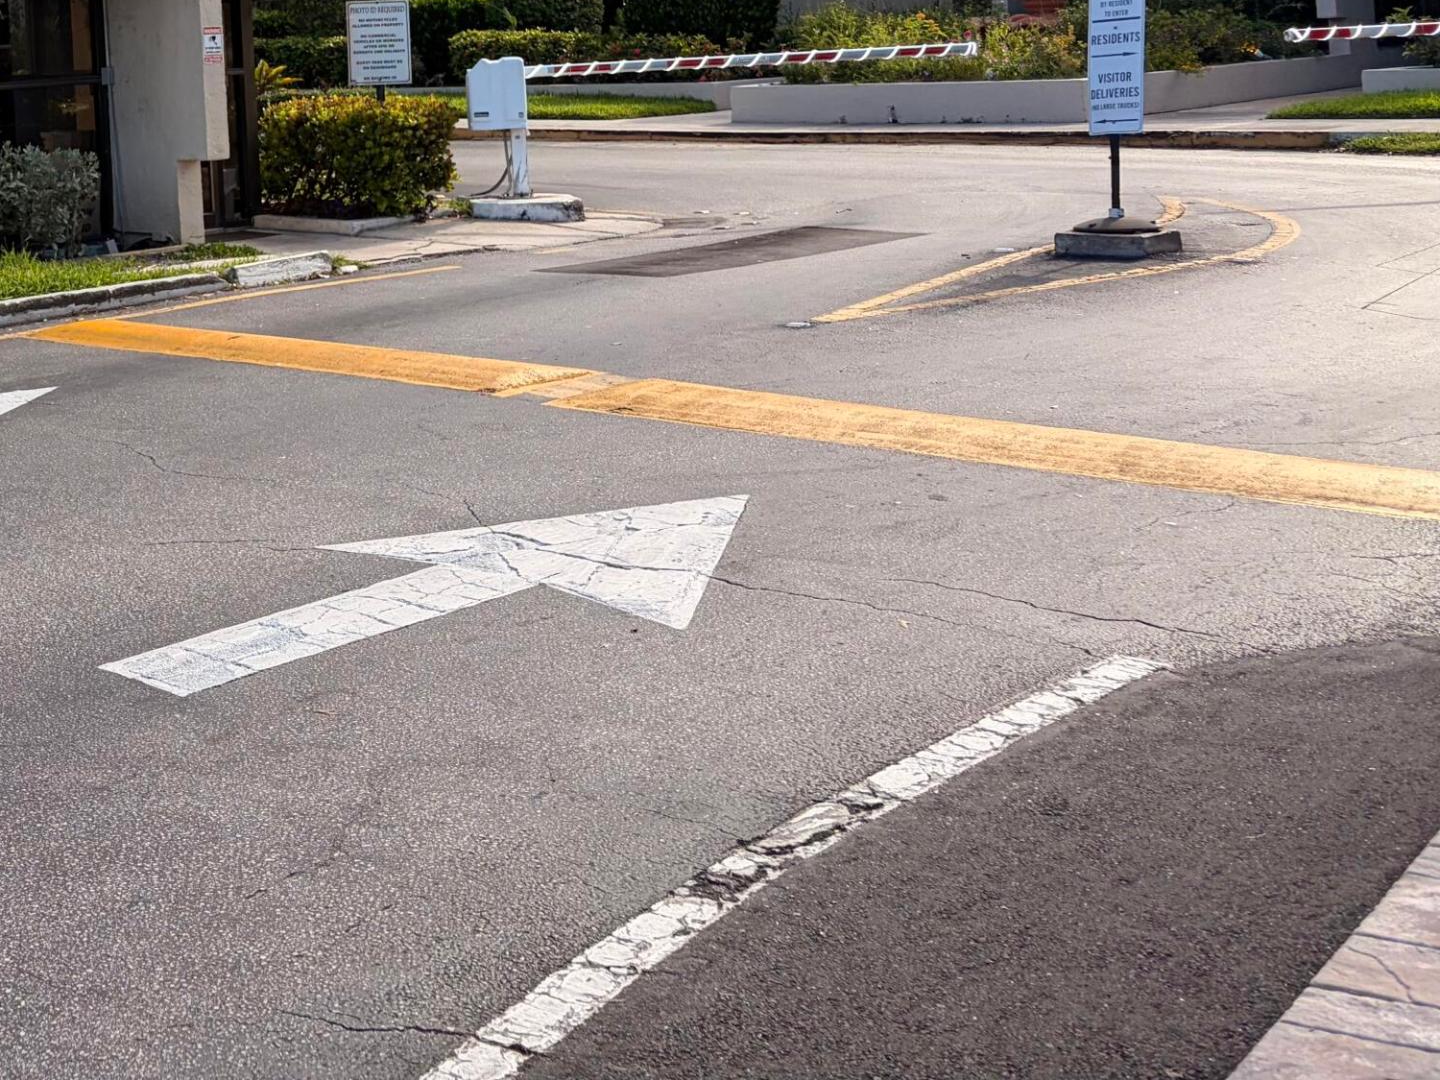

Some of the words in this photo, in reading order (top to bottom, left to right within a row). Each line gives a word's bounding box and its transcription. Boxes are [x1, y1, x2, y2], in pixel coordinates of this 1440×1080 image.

[1091, 31, 1140, 46] RESIDENTS
[1098, 71, 1132, 84] VISITOR
[1090, 86, 1140, 100] DELIVERIES
